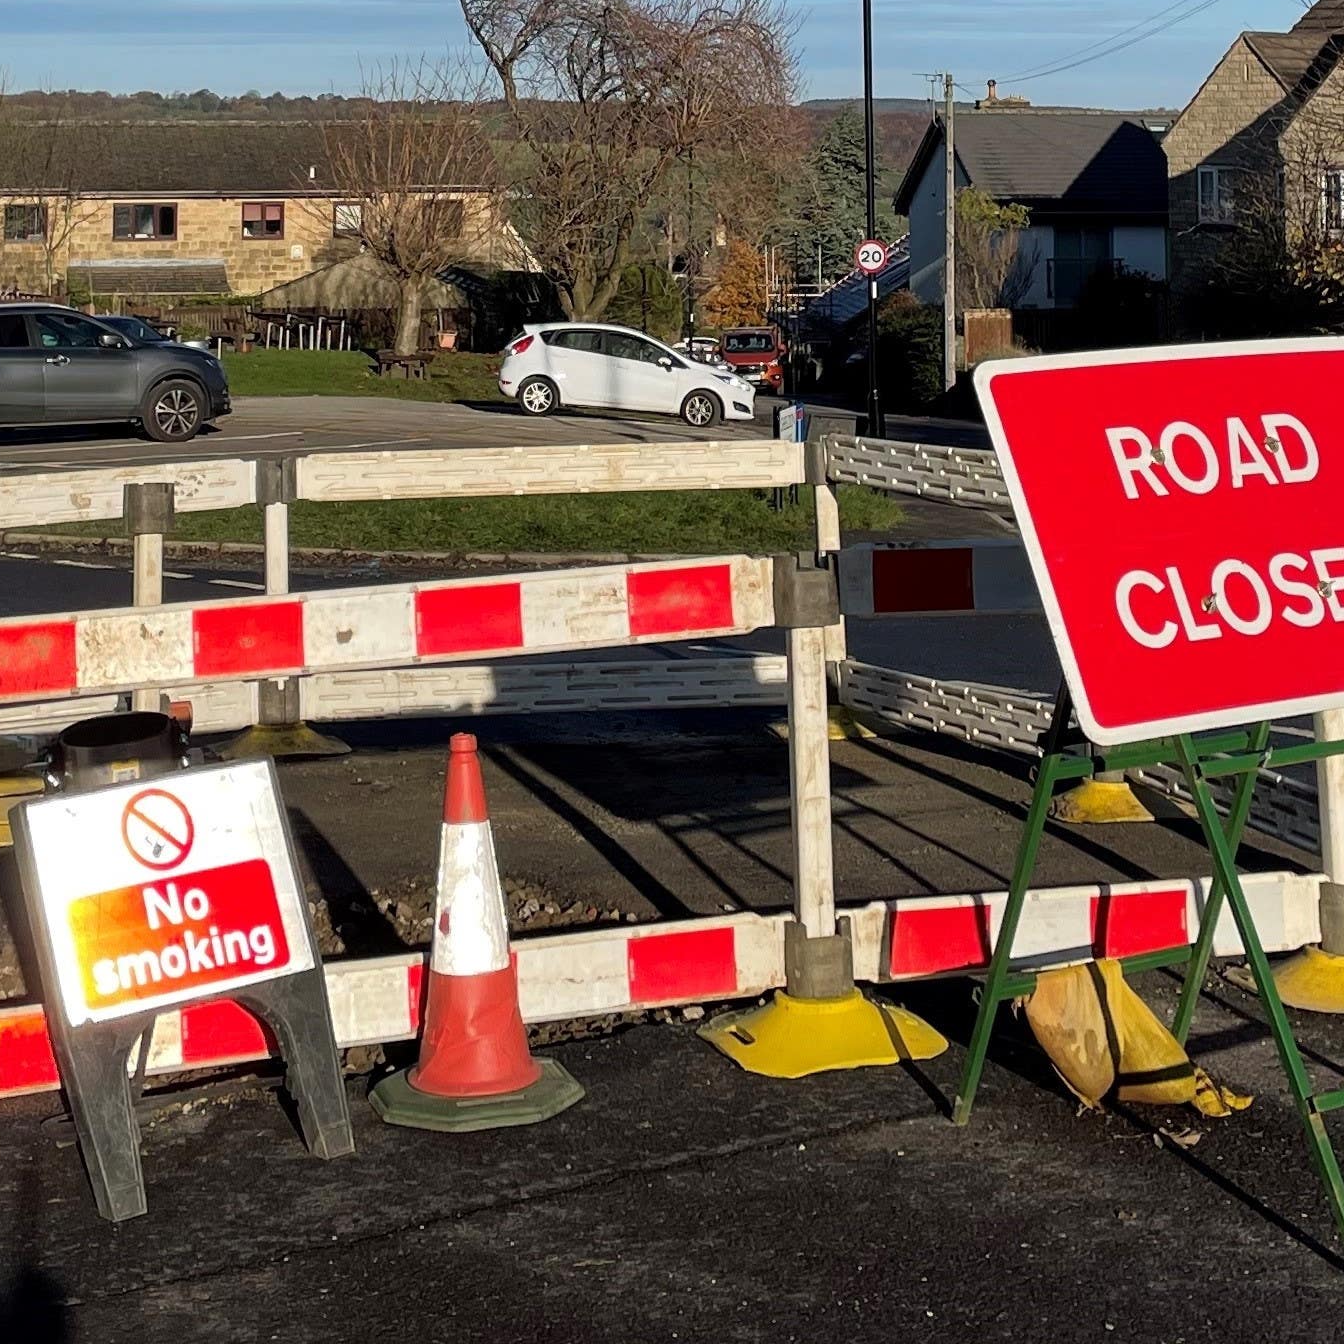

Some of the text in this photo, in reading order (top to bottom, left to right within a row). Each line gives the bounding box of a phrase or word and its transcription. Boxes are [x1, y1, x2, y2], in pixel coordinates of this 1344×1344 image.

[861, 250, 882, 263] 20
[1105, 413, 1320, 499] ROAD
[141, 883, 210, 930] No
[91, 923, 276, 996] smoking
